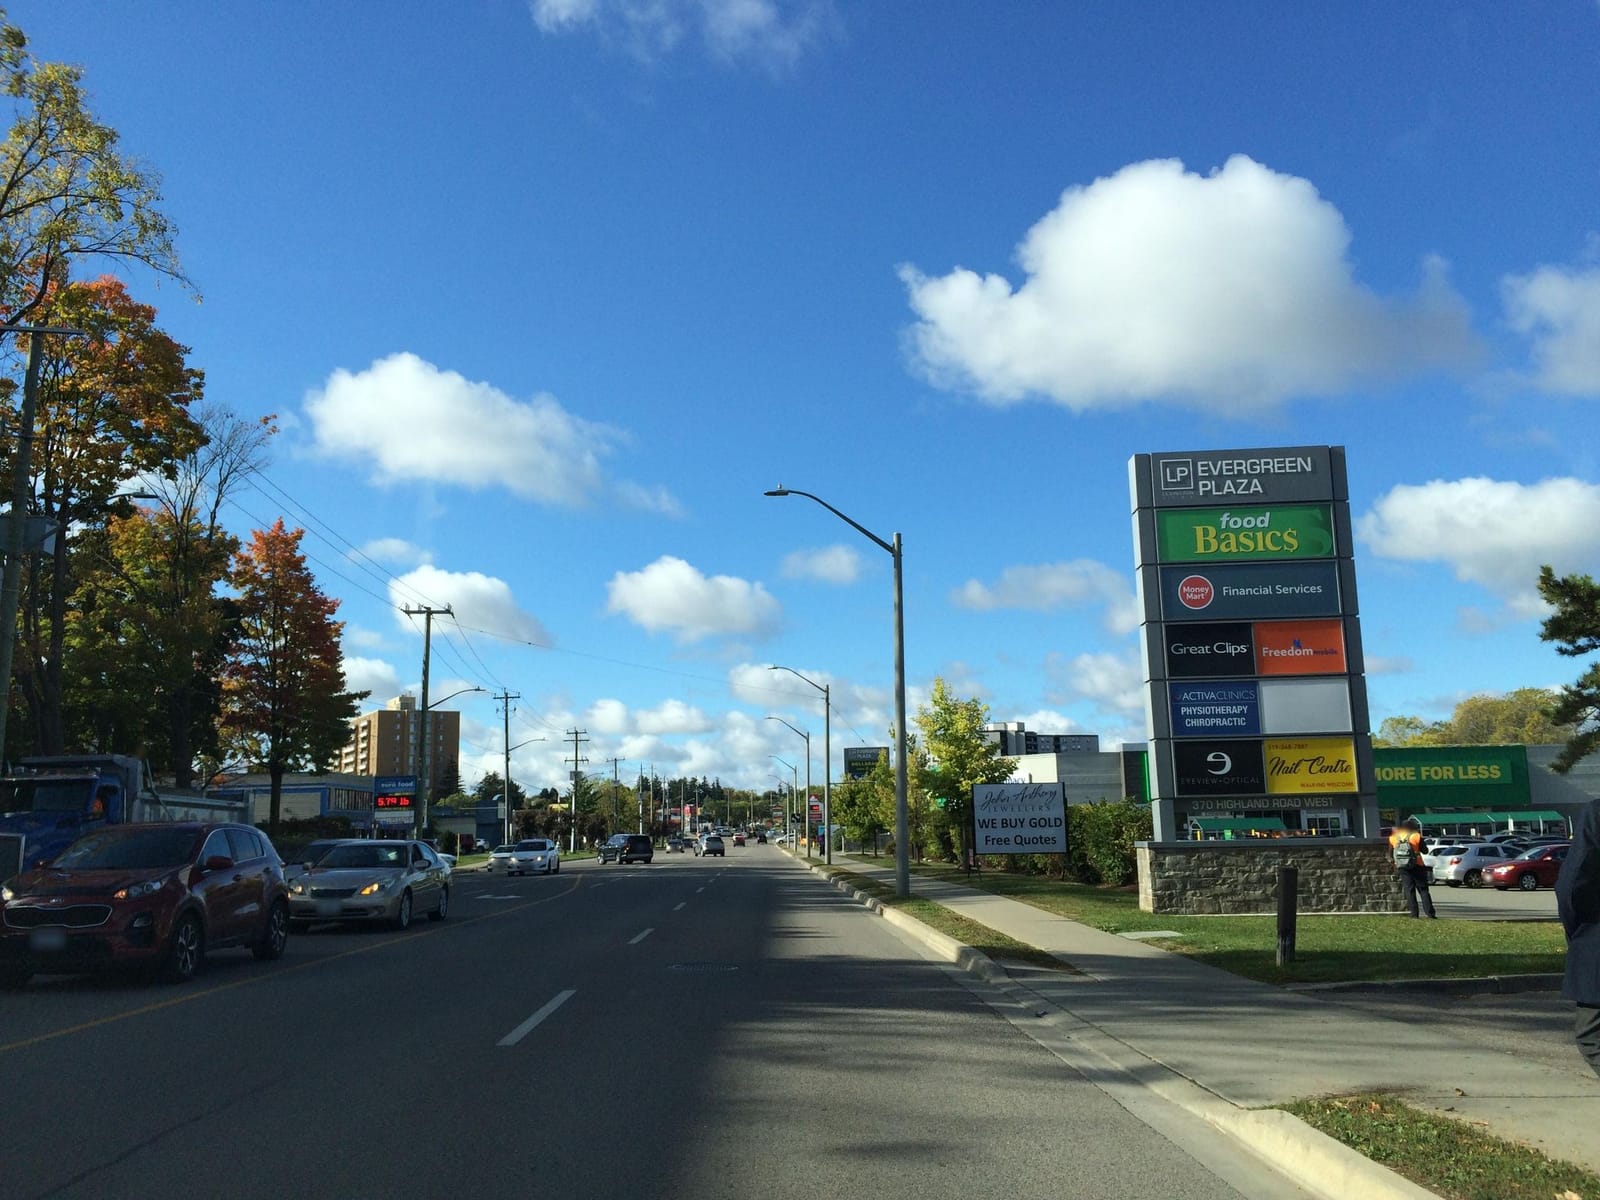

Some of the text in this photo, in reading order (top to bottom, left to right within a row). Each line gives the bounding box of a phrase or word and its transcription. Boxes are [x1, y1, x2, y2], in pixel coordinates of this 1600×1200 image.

[1197, 456, 1312, 476] EVERGREEN
[1166, 467, 1189, 482] LP
[1199, 478, 1263, 495] PLAZA
[1220, 512, 1270, 529] food
[1183, 585, 1210, 596] Money
[1222, 584, 1322, 597] Financial Services
[1171, 642, 1248, 657] Great Clips
[1262, 645, 1314, 657] Freedom
[1181, 706, 1249, 716] PHYSIOTHERAPY
[1185, 717, 1247, 727] CHIROPRACTIC
[1269, 756, 1352, 776] Nail Centre
[1421, 766, 1455, 781] FOR
[1458, 764, 1501, 779] LESS
[981, 789, 1010, 811] John
[1192, 797, 1334, 810] 370 HIGHLAND ROAD WEST
[977, 818, 1063, 829] WE BUY GOLD
[985, 834, 1057, 846] Free Quotes
